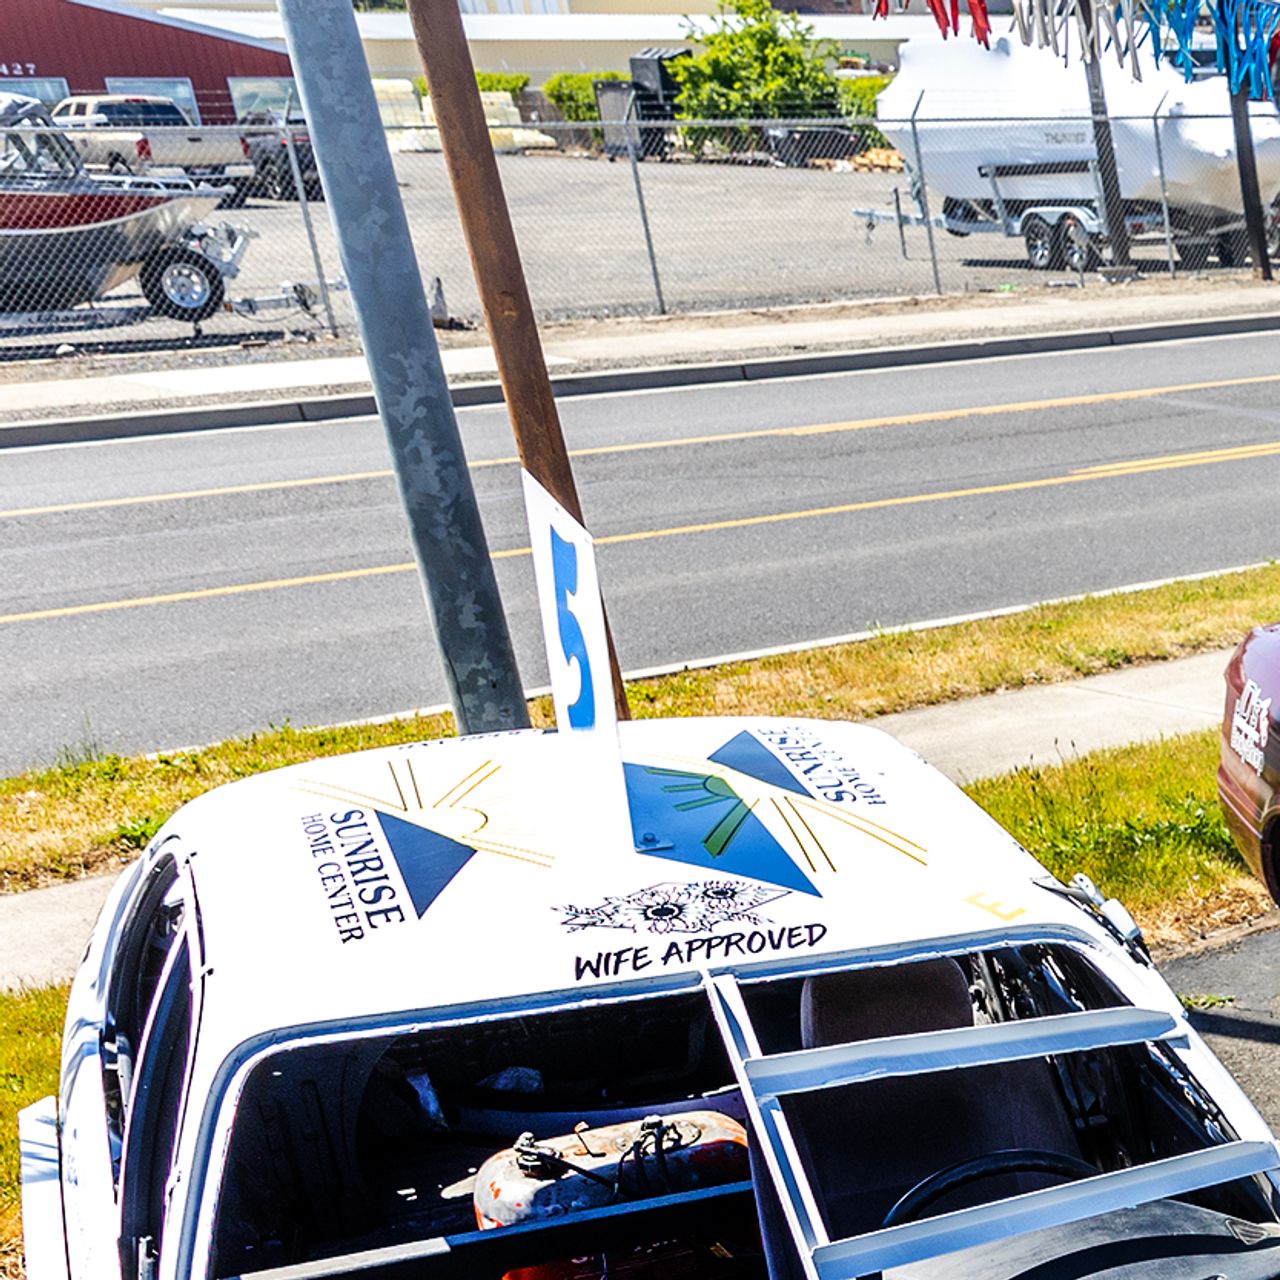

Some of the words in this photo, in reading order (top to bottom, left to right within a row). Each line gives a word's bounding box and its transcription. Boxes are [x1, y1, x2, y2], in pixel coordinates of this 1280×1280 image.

[549, 524, 596, 731] 5
[758, 728, 857, 803] SUNRISE
[301, 812, 336, 859] HOME
[329, 809, 406, 930] SUNRISE
[317, 861, 366, 945] CENTER
[574, 946, 653, 982] WIFE
[661, 923, 828, 967] APPROVED
